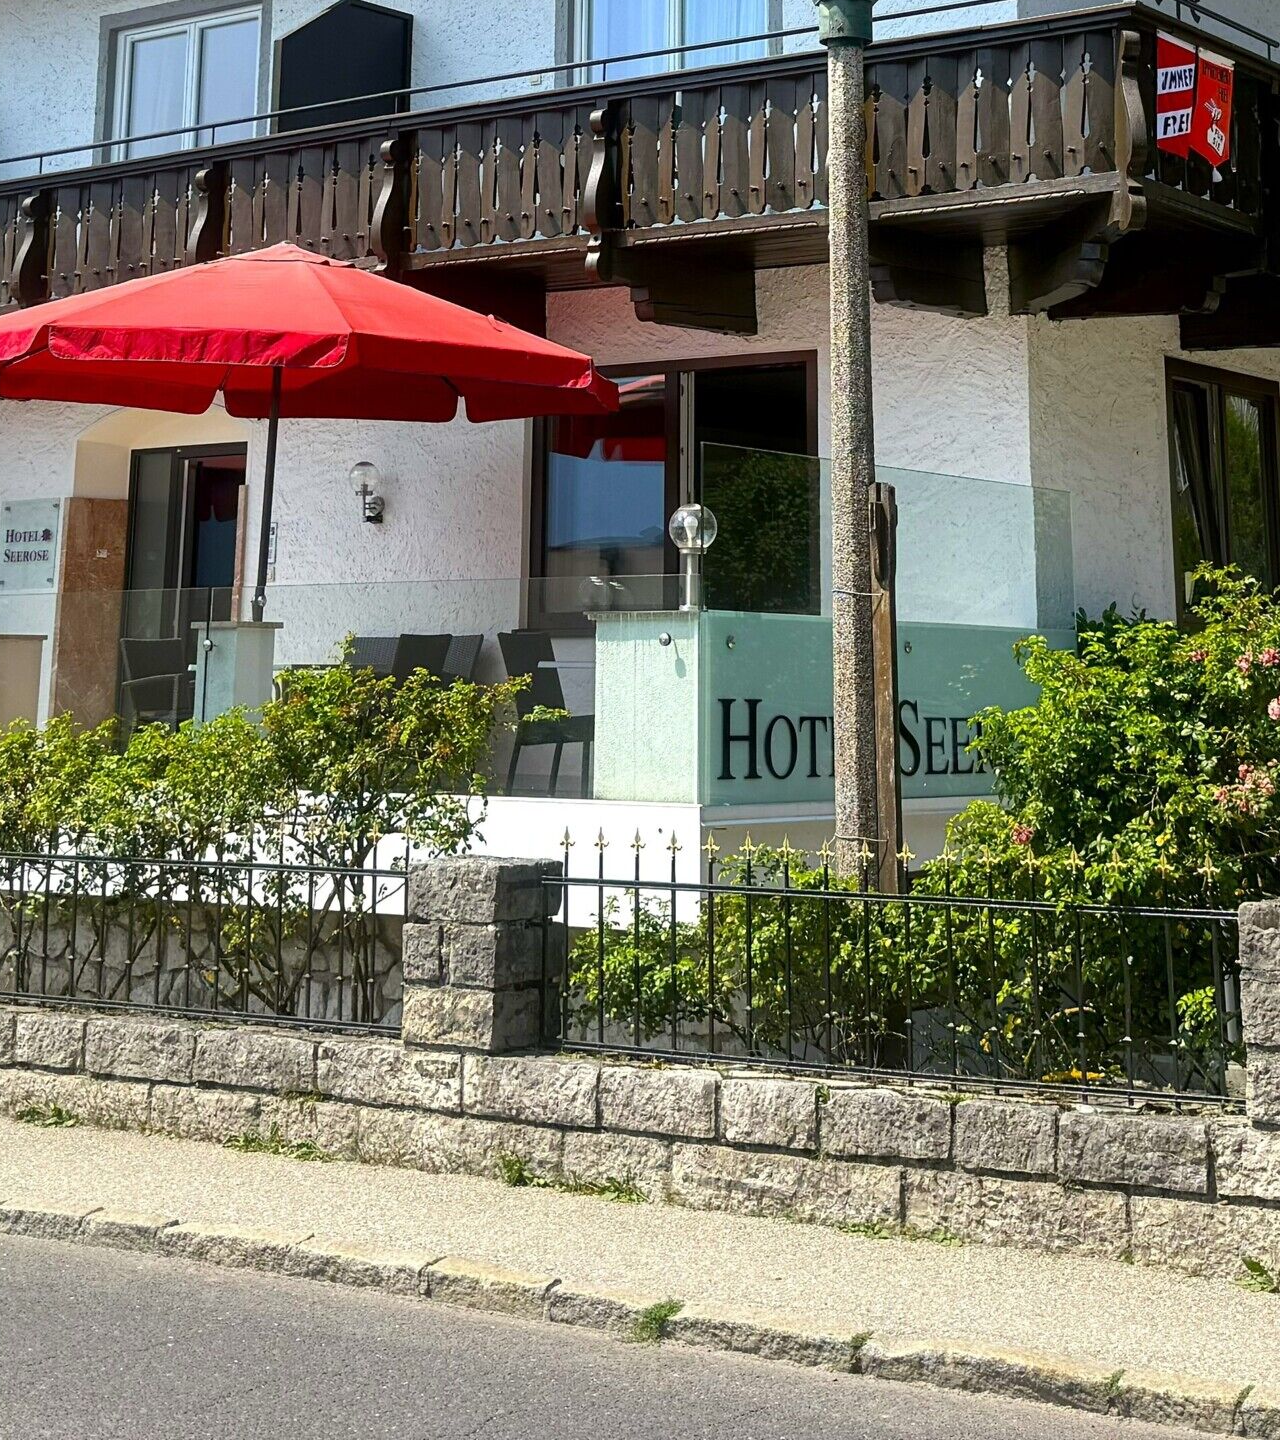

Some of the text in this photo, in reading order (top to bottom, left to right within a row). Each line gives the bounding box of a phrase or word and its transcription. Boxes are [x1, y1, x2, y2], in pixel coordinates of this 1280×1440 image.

[1162, 112, 1191, 136] FREI
[6, 529, 41, 543] HOTEL
[3, 548, 49, 563] SEEROSE
[717, 698, 836, 781] HOT
